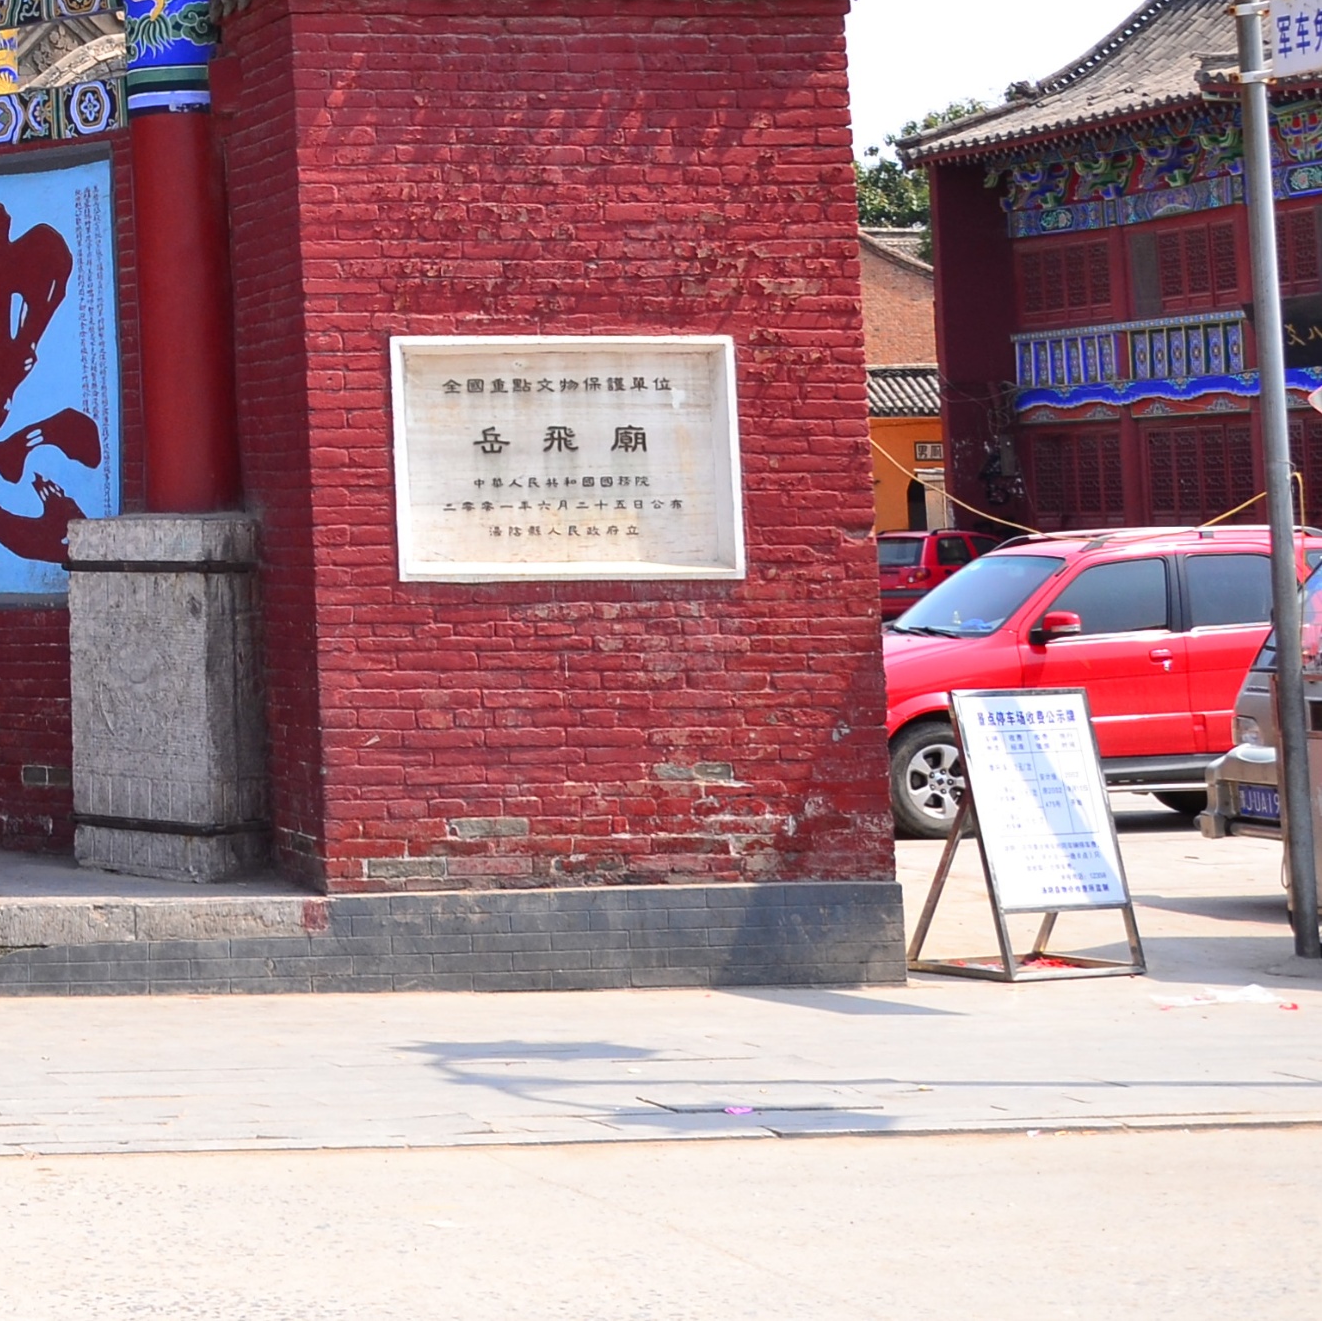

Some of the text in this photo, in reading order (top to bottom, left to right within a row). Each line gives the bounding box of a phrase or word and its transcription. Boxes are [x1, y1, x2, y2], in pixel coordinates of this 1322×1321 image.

[441, 377, 673, 395] 全國重點文物保護單位
[473, 424, 648, 454] 岳飛廟
[473, 476, 650, 489] 中華人民共和國國務院
